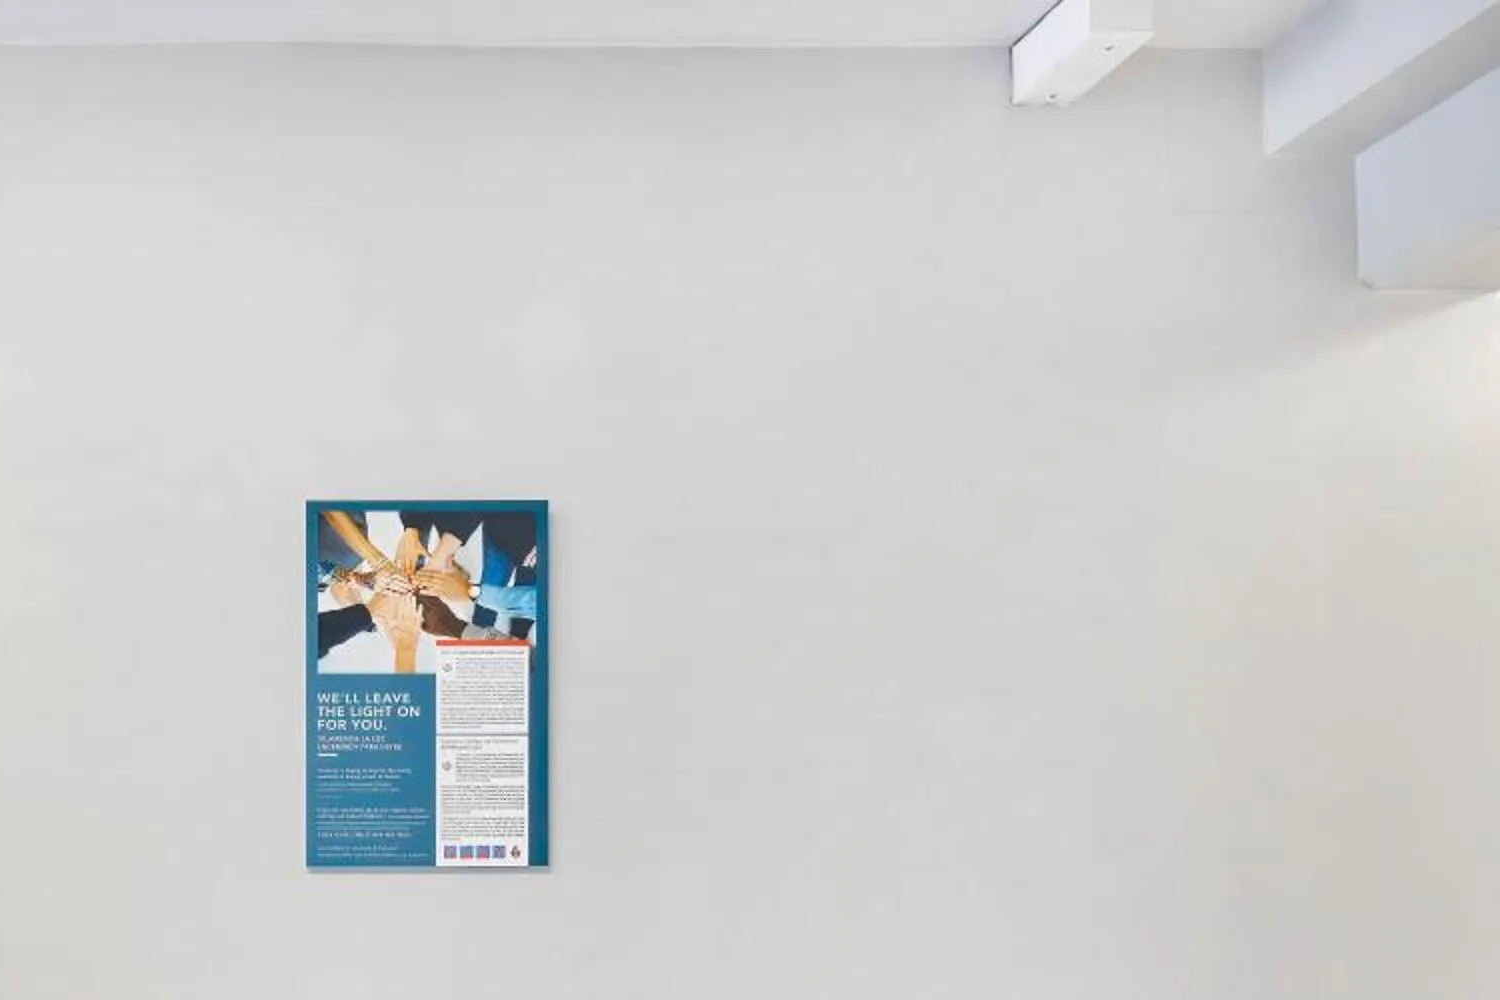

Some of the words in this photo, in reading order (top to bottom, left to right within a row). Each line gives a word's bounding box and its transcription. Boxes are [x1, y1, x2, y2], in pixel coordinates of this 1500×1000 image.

[317, 692, 360, 704] WE'LL
[365, 692, 411, 704] LEAVE
[318, 706, 345, 717] THE
[350, 706, 393, 717] LIGHT
[397, 706, 421, 717] ON
[317, 719, 347, 731] FOR
[351, 719, 388, 731] YOU.
